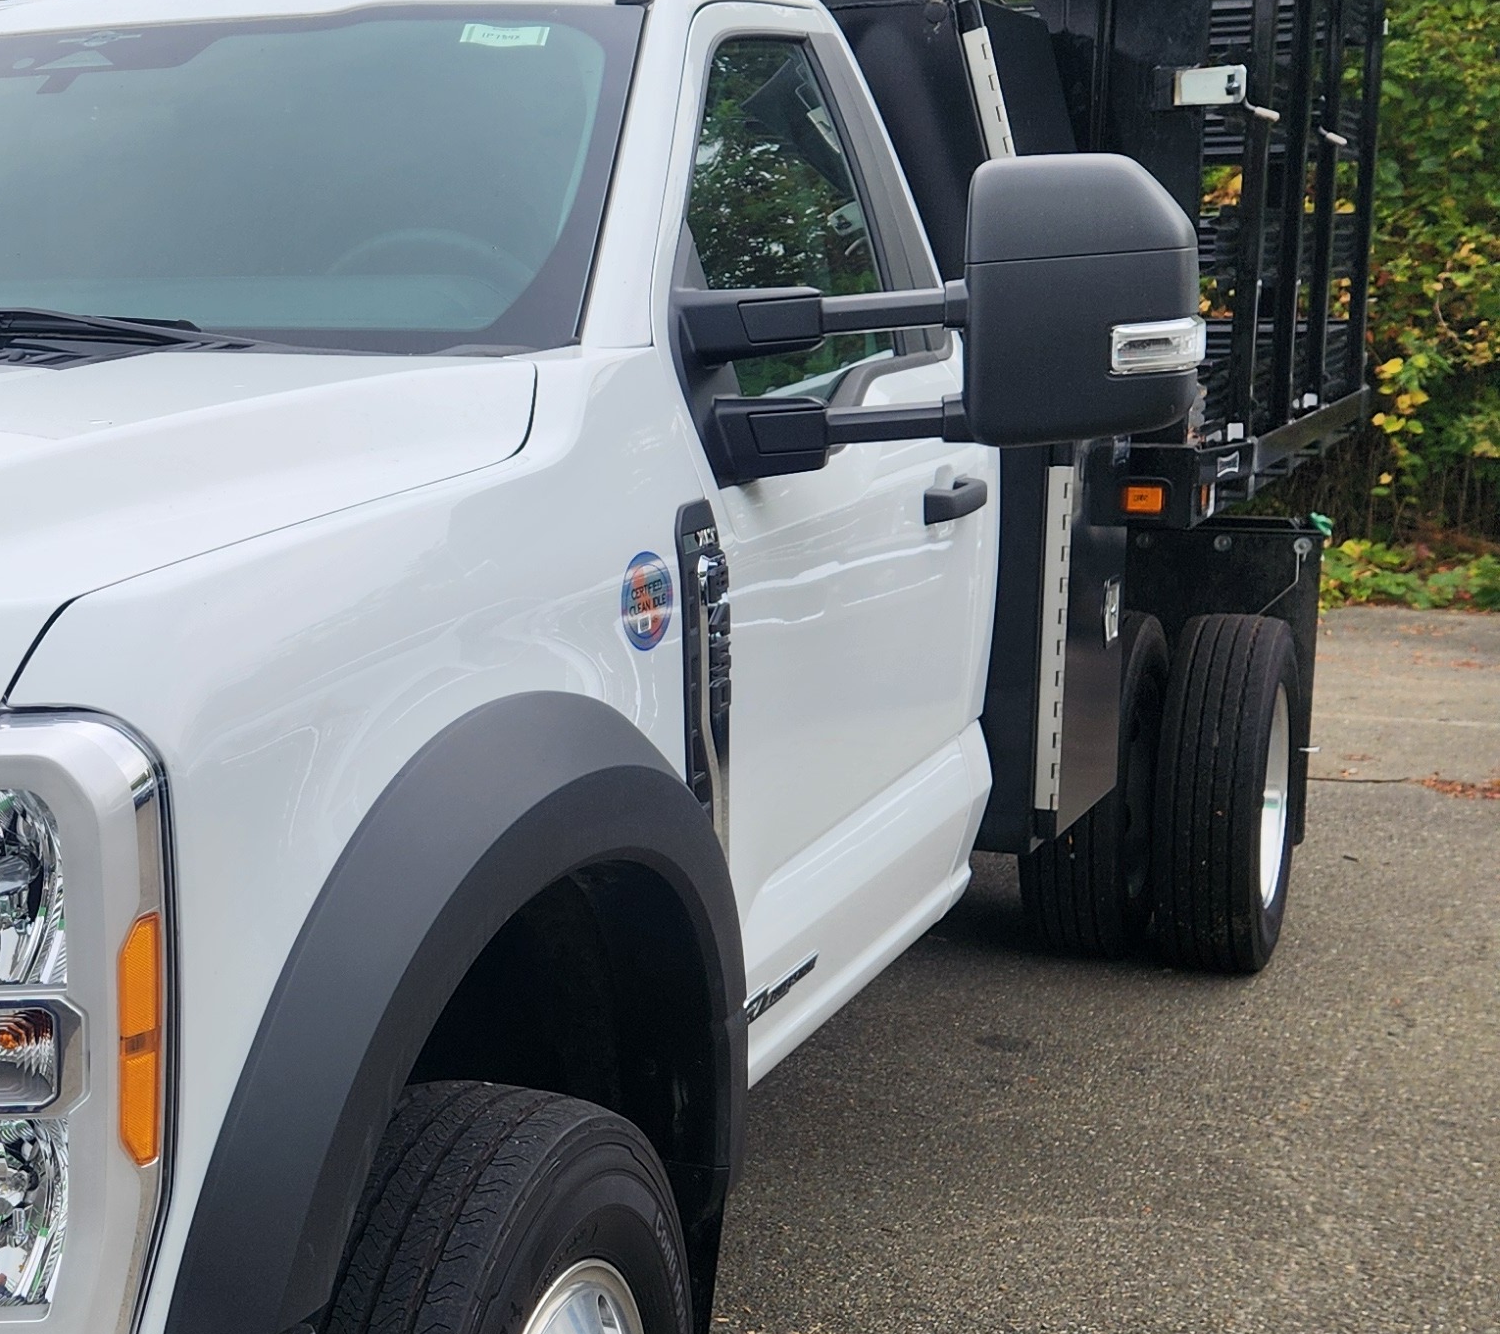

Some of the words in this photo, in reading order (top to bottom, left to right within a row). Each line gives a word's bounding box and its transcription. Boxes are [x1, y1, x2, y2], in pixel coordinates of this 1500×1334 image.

[630, 578, 663, 601] CERTIFIED
[629, 600, 651, 617] CLEAN
[652, 593, 667, 609] IDLE
